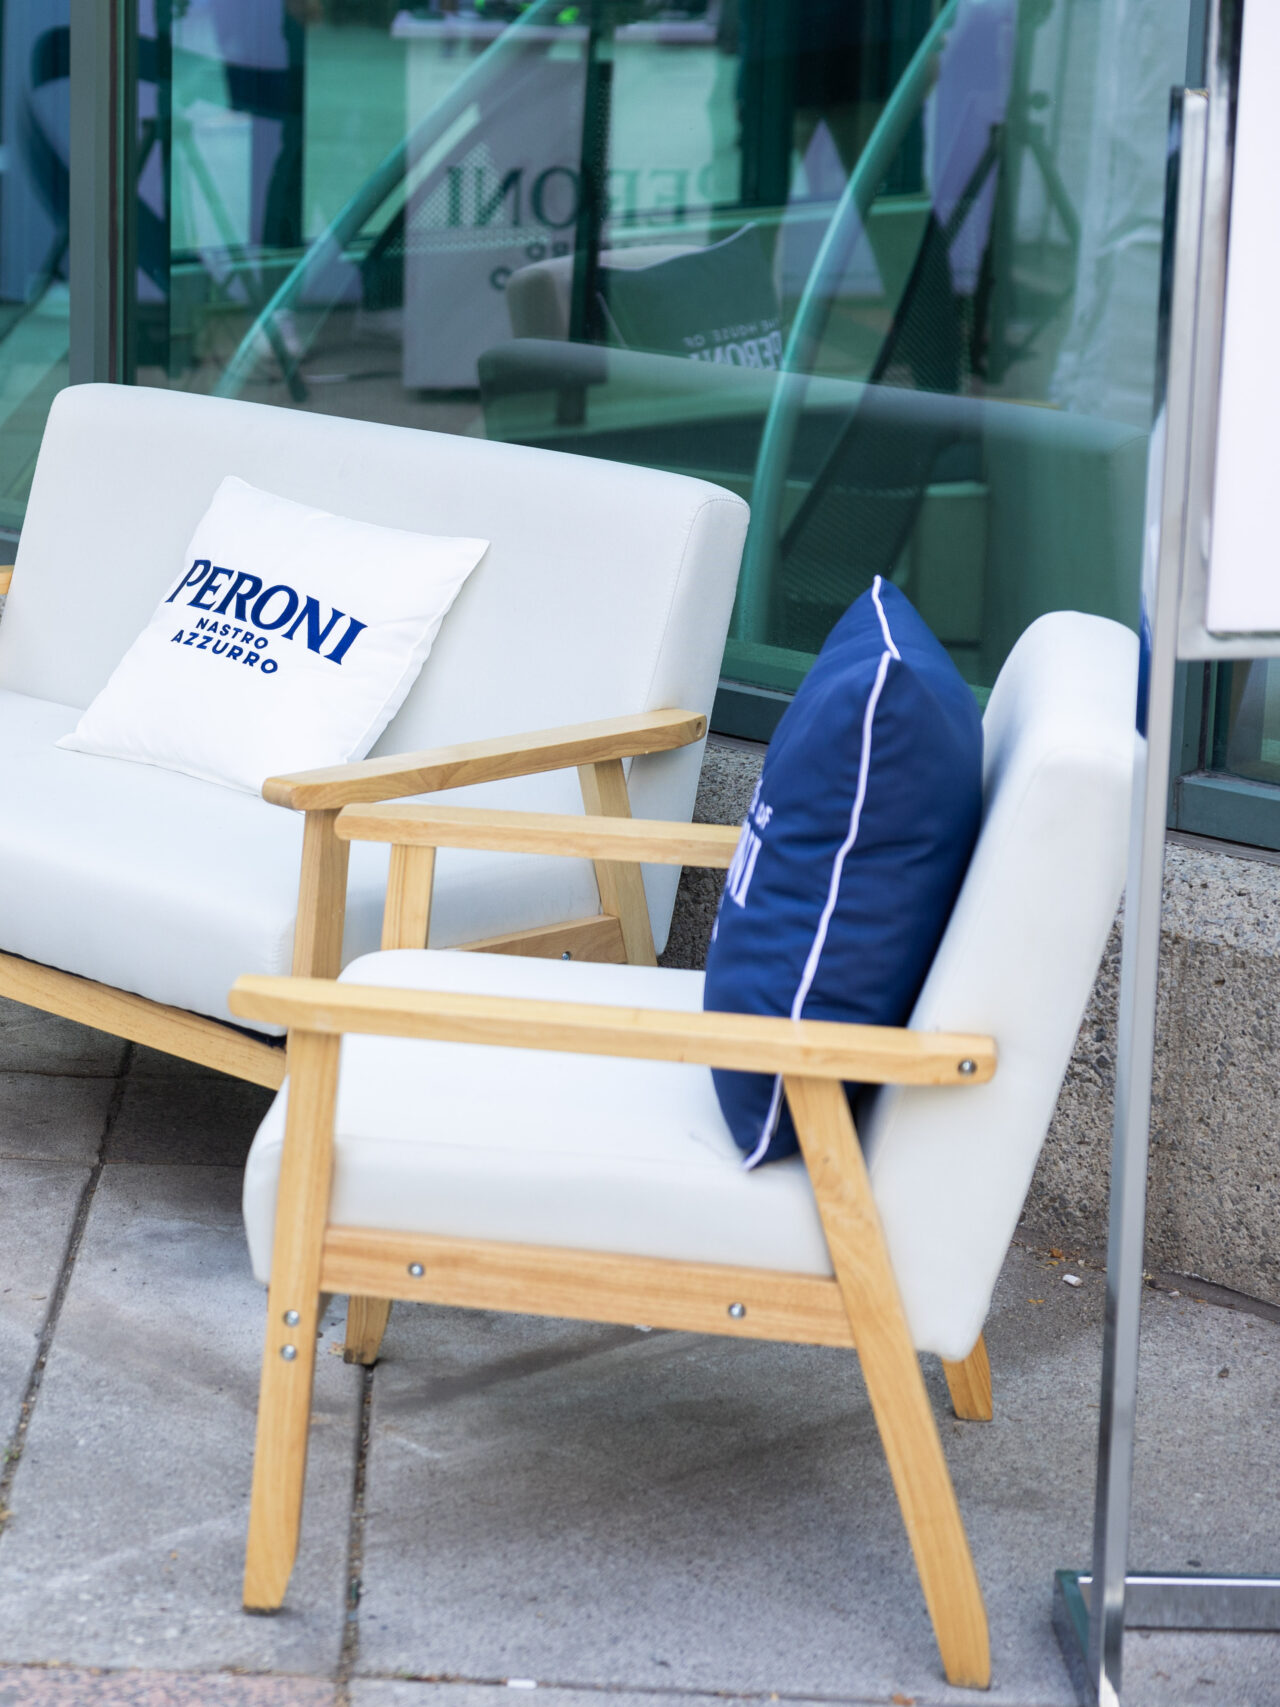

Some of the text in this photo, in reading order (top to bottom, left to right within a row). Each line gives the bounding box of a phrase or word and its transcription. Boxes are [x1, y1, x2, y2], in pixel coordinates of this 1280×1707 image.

[165, 559, 369, 666] PERONI
[195, 617, 269, 649] NASTRO
[170, 629, 279, 674] AZZURRO
